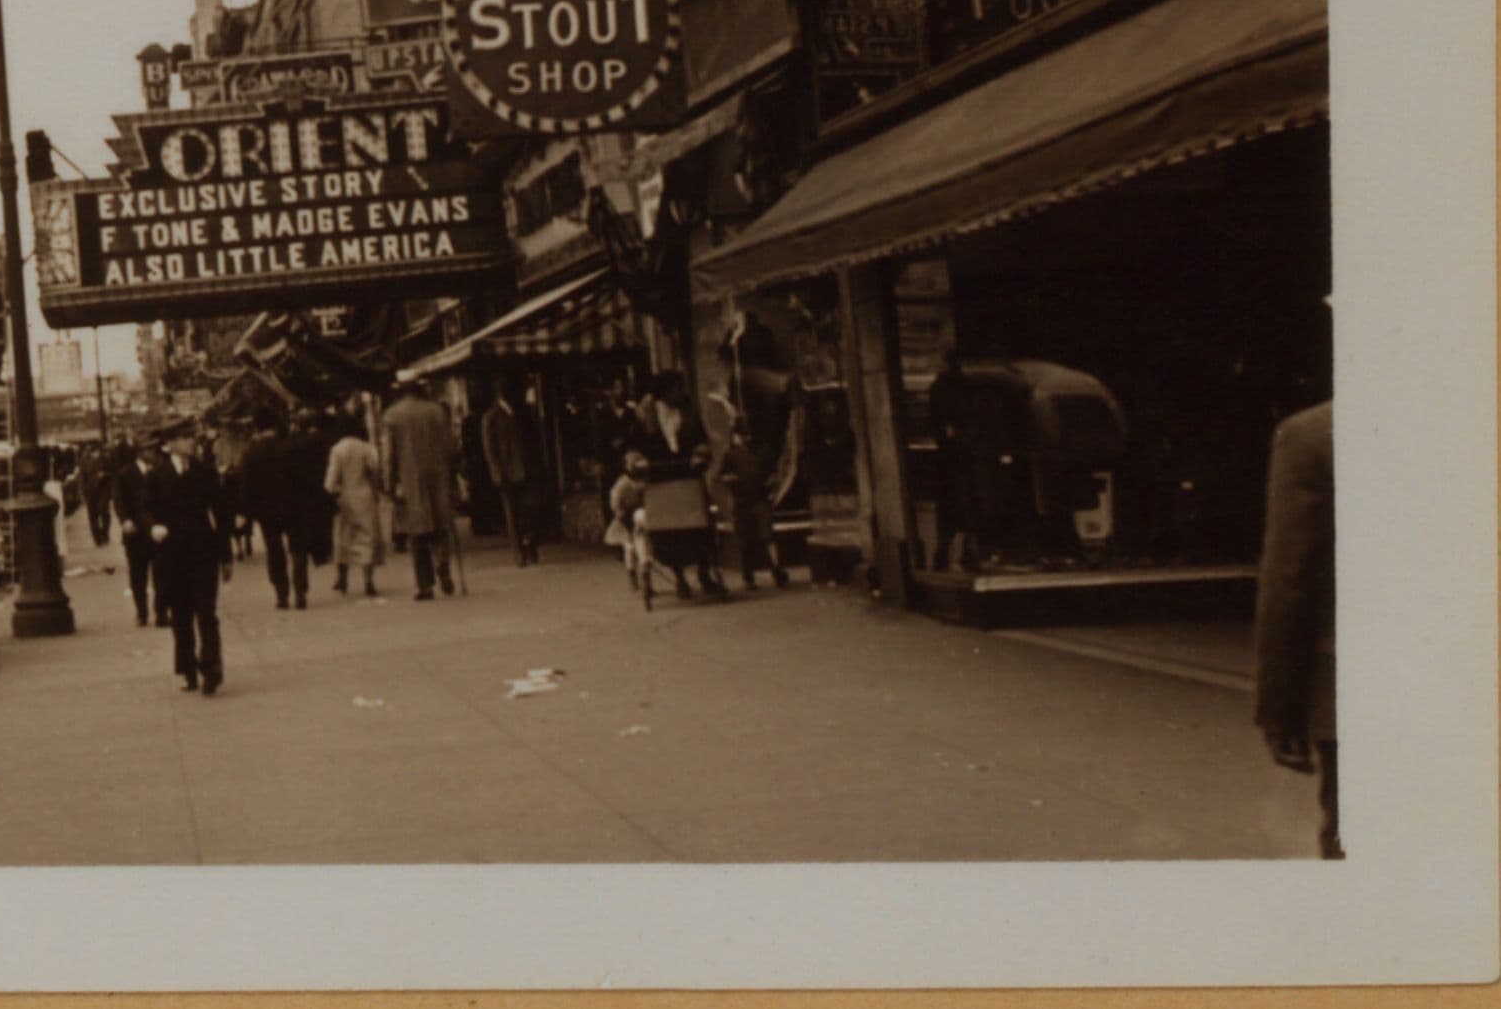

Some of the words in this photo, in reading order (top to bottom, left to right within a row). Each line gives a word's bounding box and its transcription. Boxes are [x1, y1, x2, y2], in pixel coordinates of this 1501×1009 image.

[507, 59, 628, 93] SHOP
[159, 108, 439, 183] ORIENT
[99, 180, 265, 221] EXCLUSIVE
[279, 171, 383, 203] STORY
[100, 226, 116, 253] F
[133, 218, 208, 251] TONE
[221, 215, 240, 242] &
[368, 195, 470, 227] EVANS
[106, 252, 185, 286] ALSO
[198, 243, 306, 279] LITTLE
[319, 230, 456, 268] AMERICA
